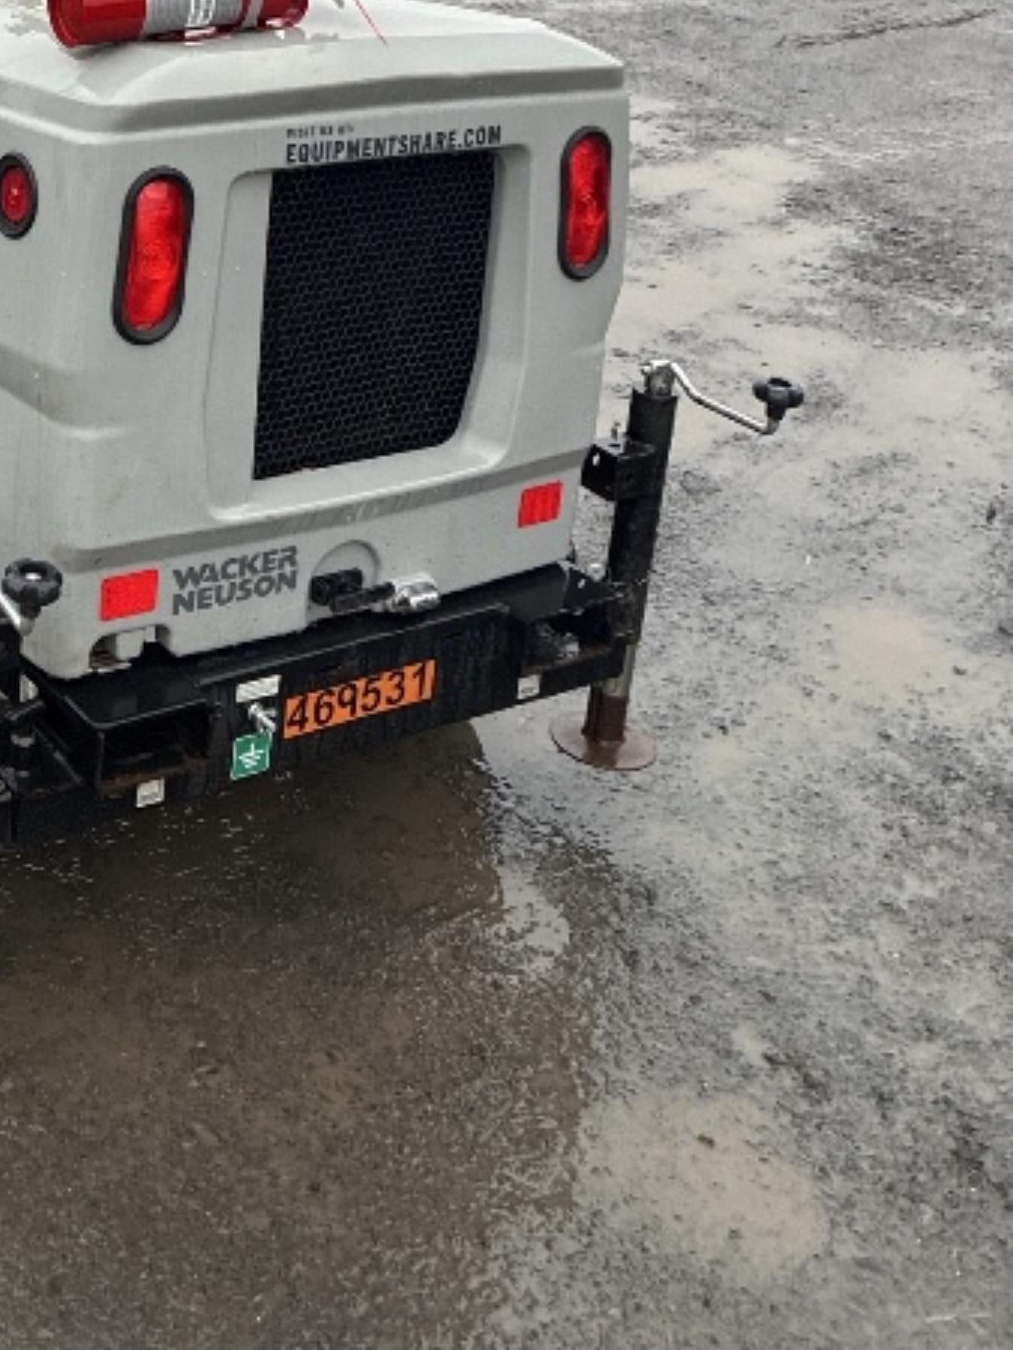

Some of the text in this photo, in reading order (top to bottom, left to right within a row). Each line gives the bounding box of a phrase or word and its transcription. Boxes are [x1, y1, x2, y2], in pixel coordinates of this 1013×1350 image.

[286, 124, 503, 163] EQUIPMENTSHARE.COM
[171, 545, 298, 591] WACKER
[171, 569, 299, 616] NEUSON
[287, 662, 427, 734] 469531
